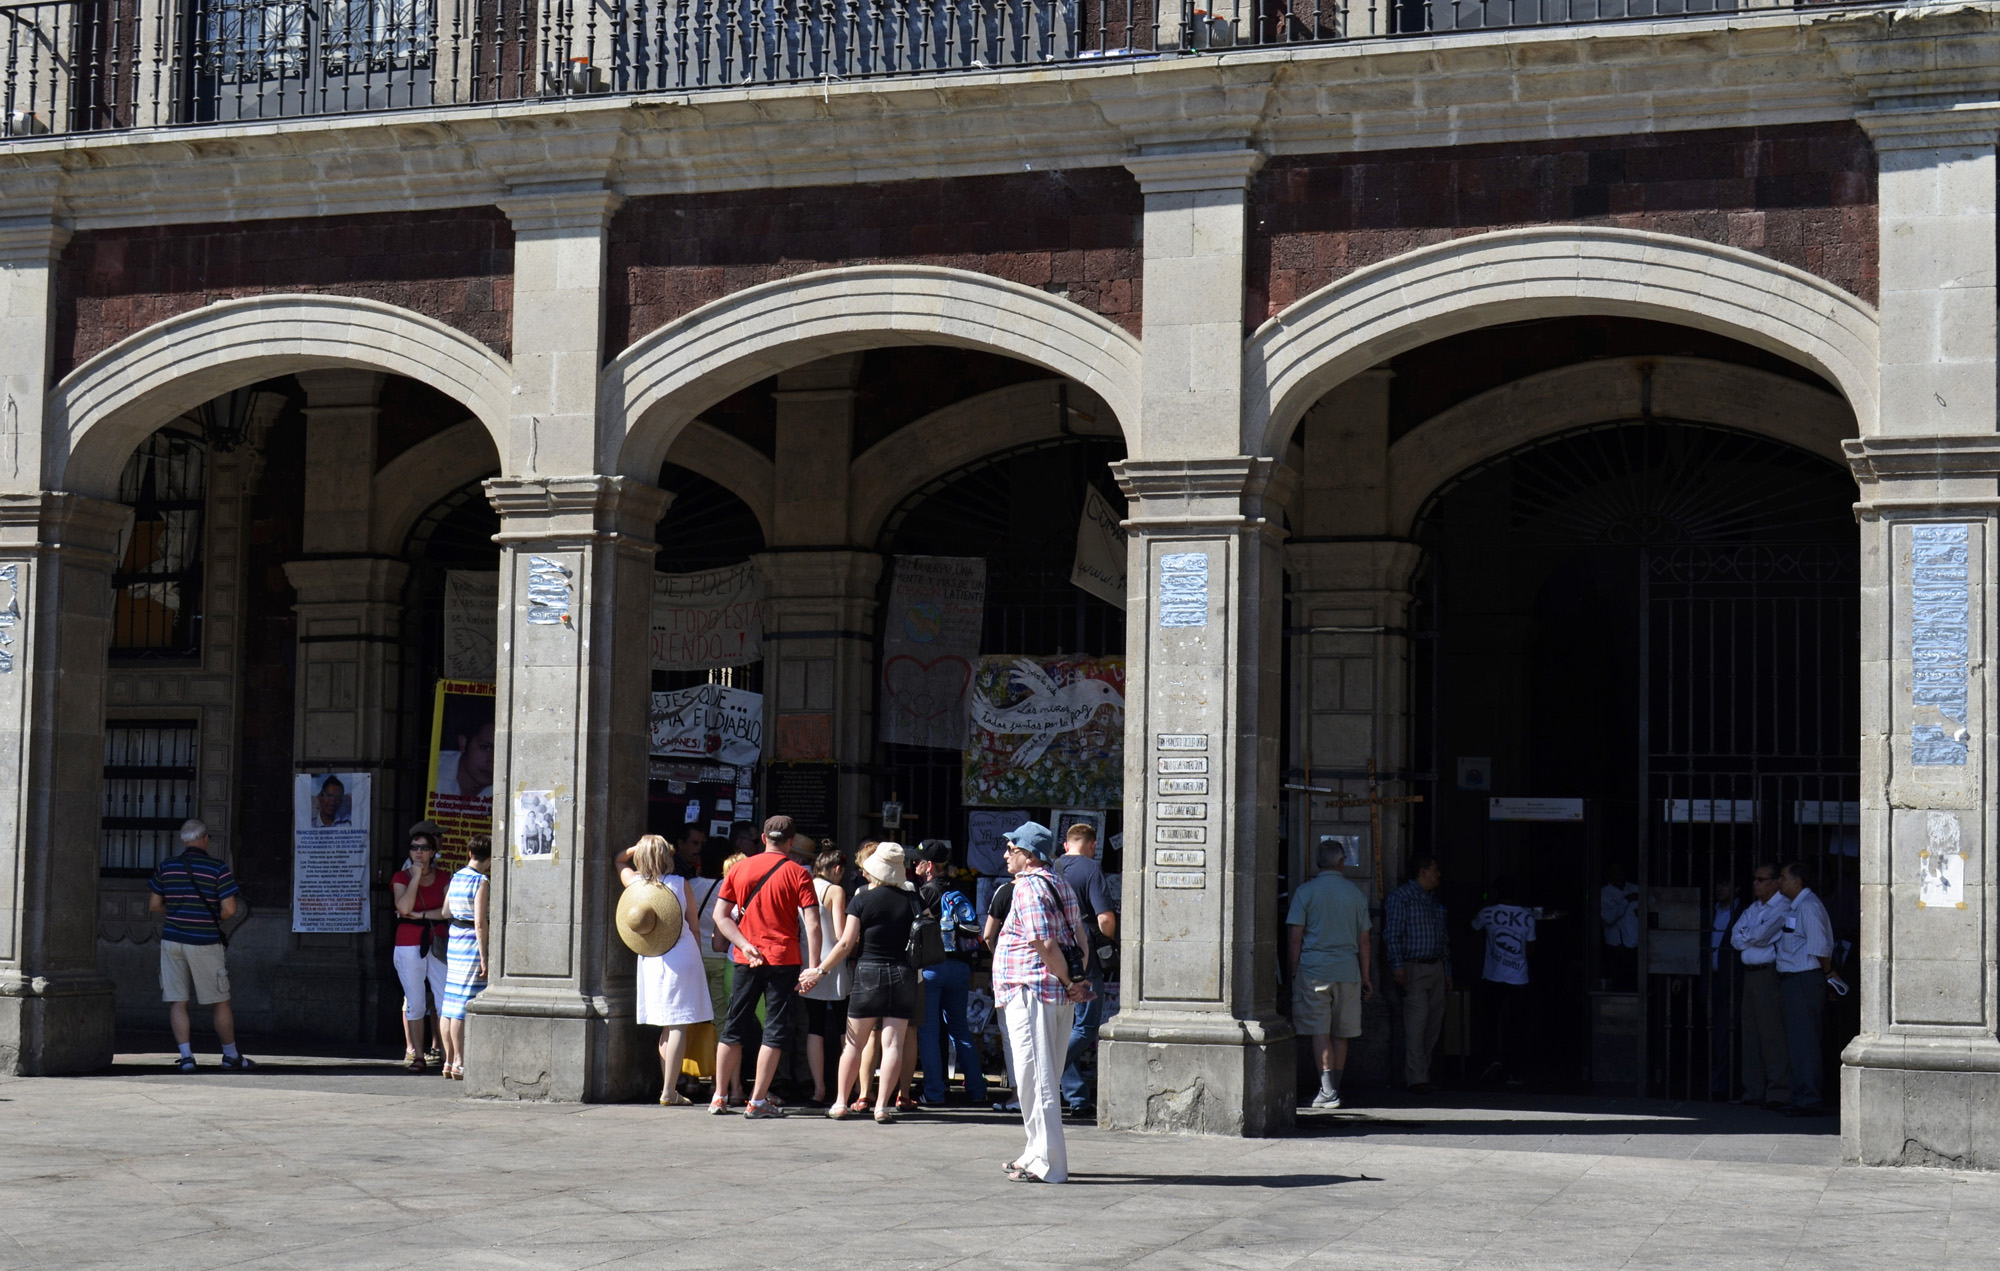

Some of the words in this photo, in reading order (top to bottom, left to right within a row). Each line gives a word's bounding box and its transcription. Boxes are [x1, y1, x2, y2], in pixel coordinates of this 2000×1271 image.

[668, 608, 720, 634] TODO
[454, 684, 468, 695] mayo
[468, 683, 476, 693] del
